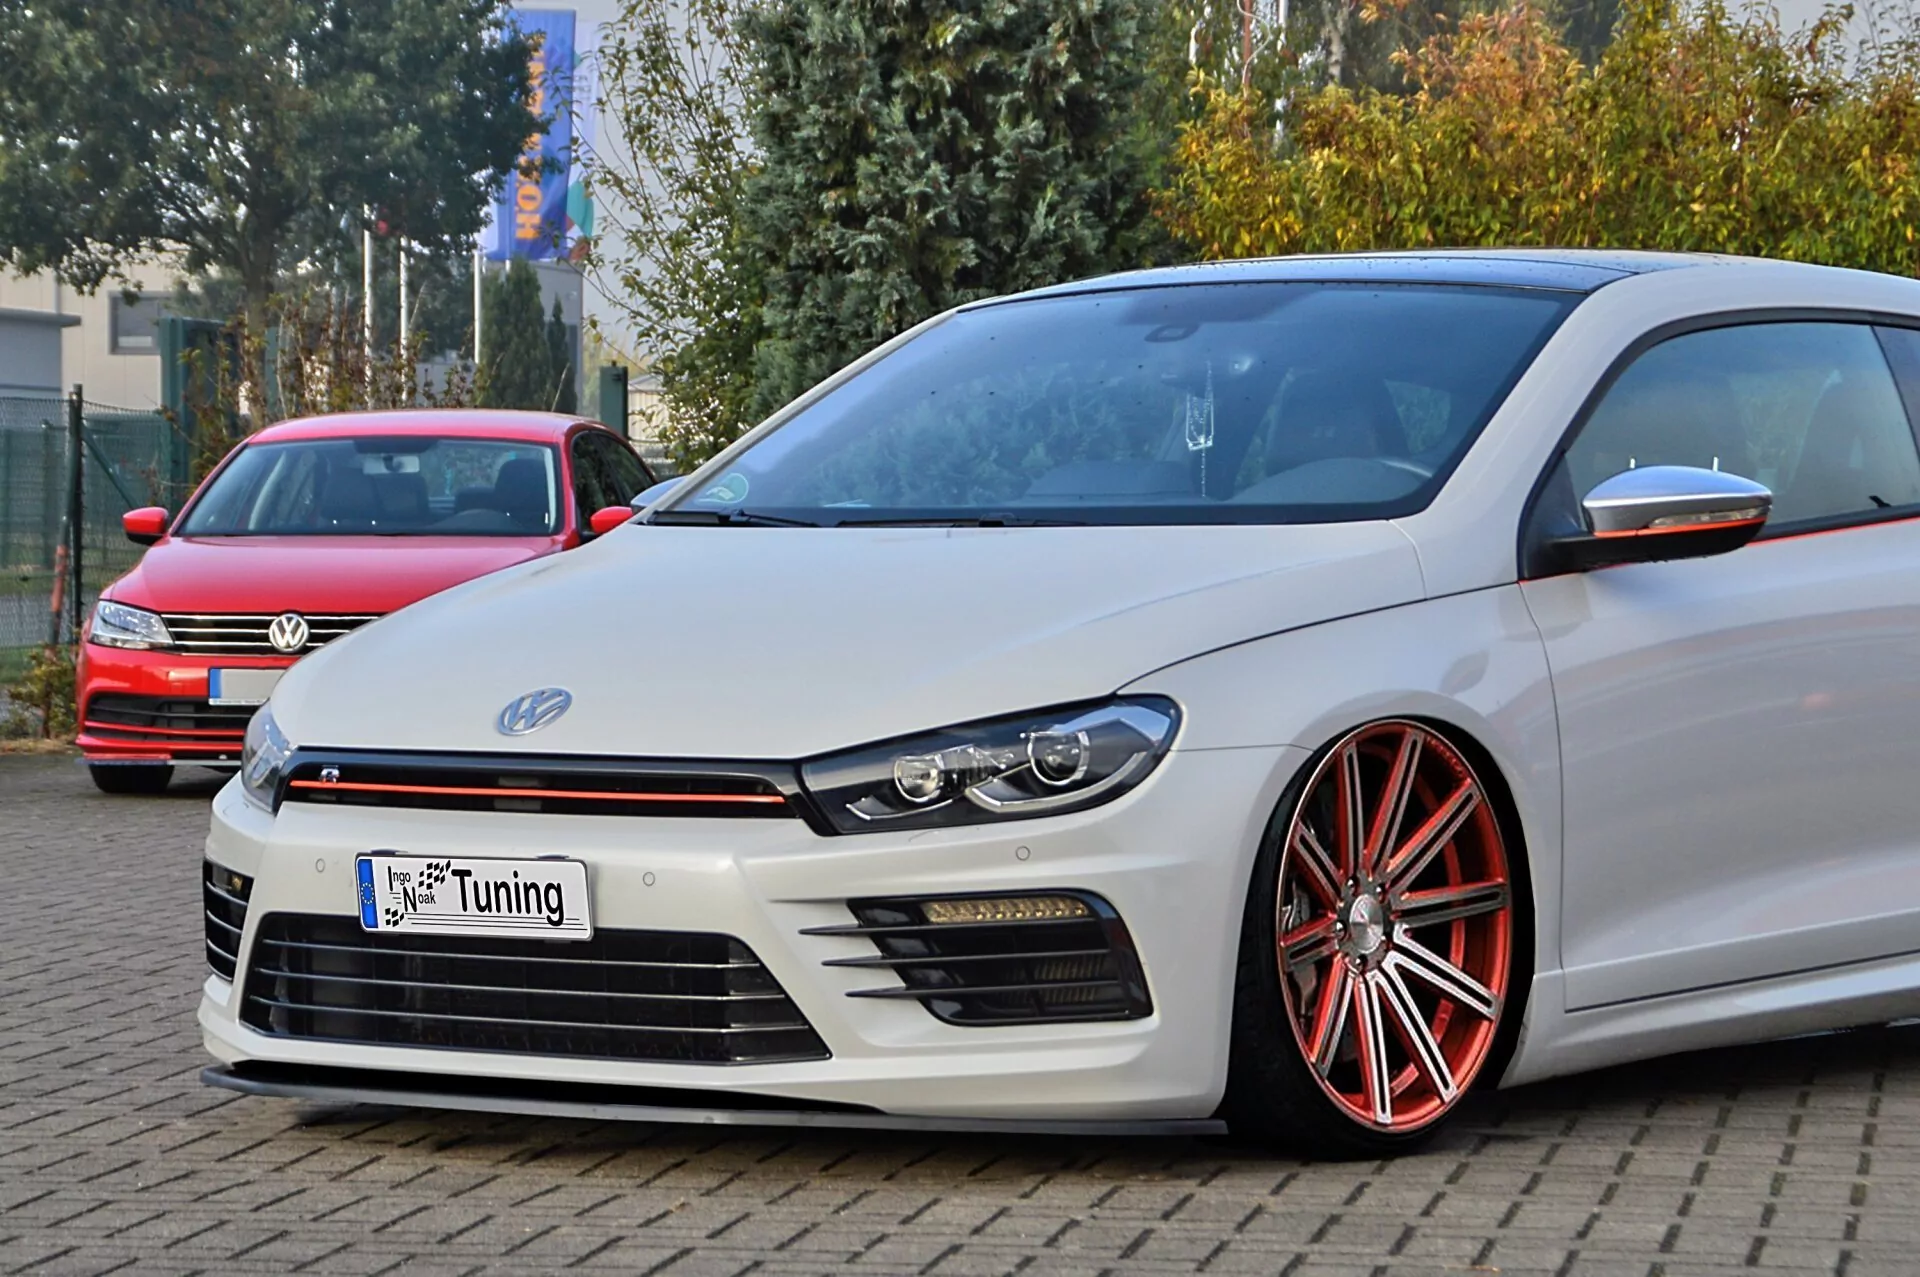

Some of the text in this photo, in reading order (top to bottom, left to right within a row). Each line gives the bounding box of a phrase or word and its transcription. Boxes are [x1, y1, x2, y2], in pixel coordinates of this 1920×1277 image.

[387, 866, 411, 892] Ingo
[403, 886, 436, 912] Noak
[451, 869, 564, 927] Tuning
